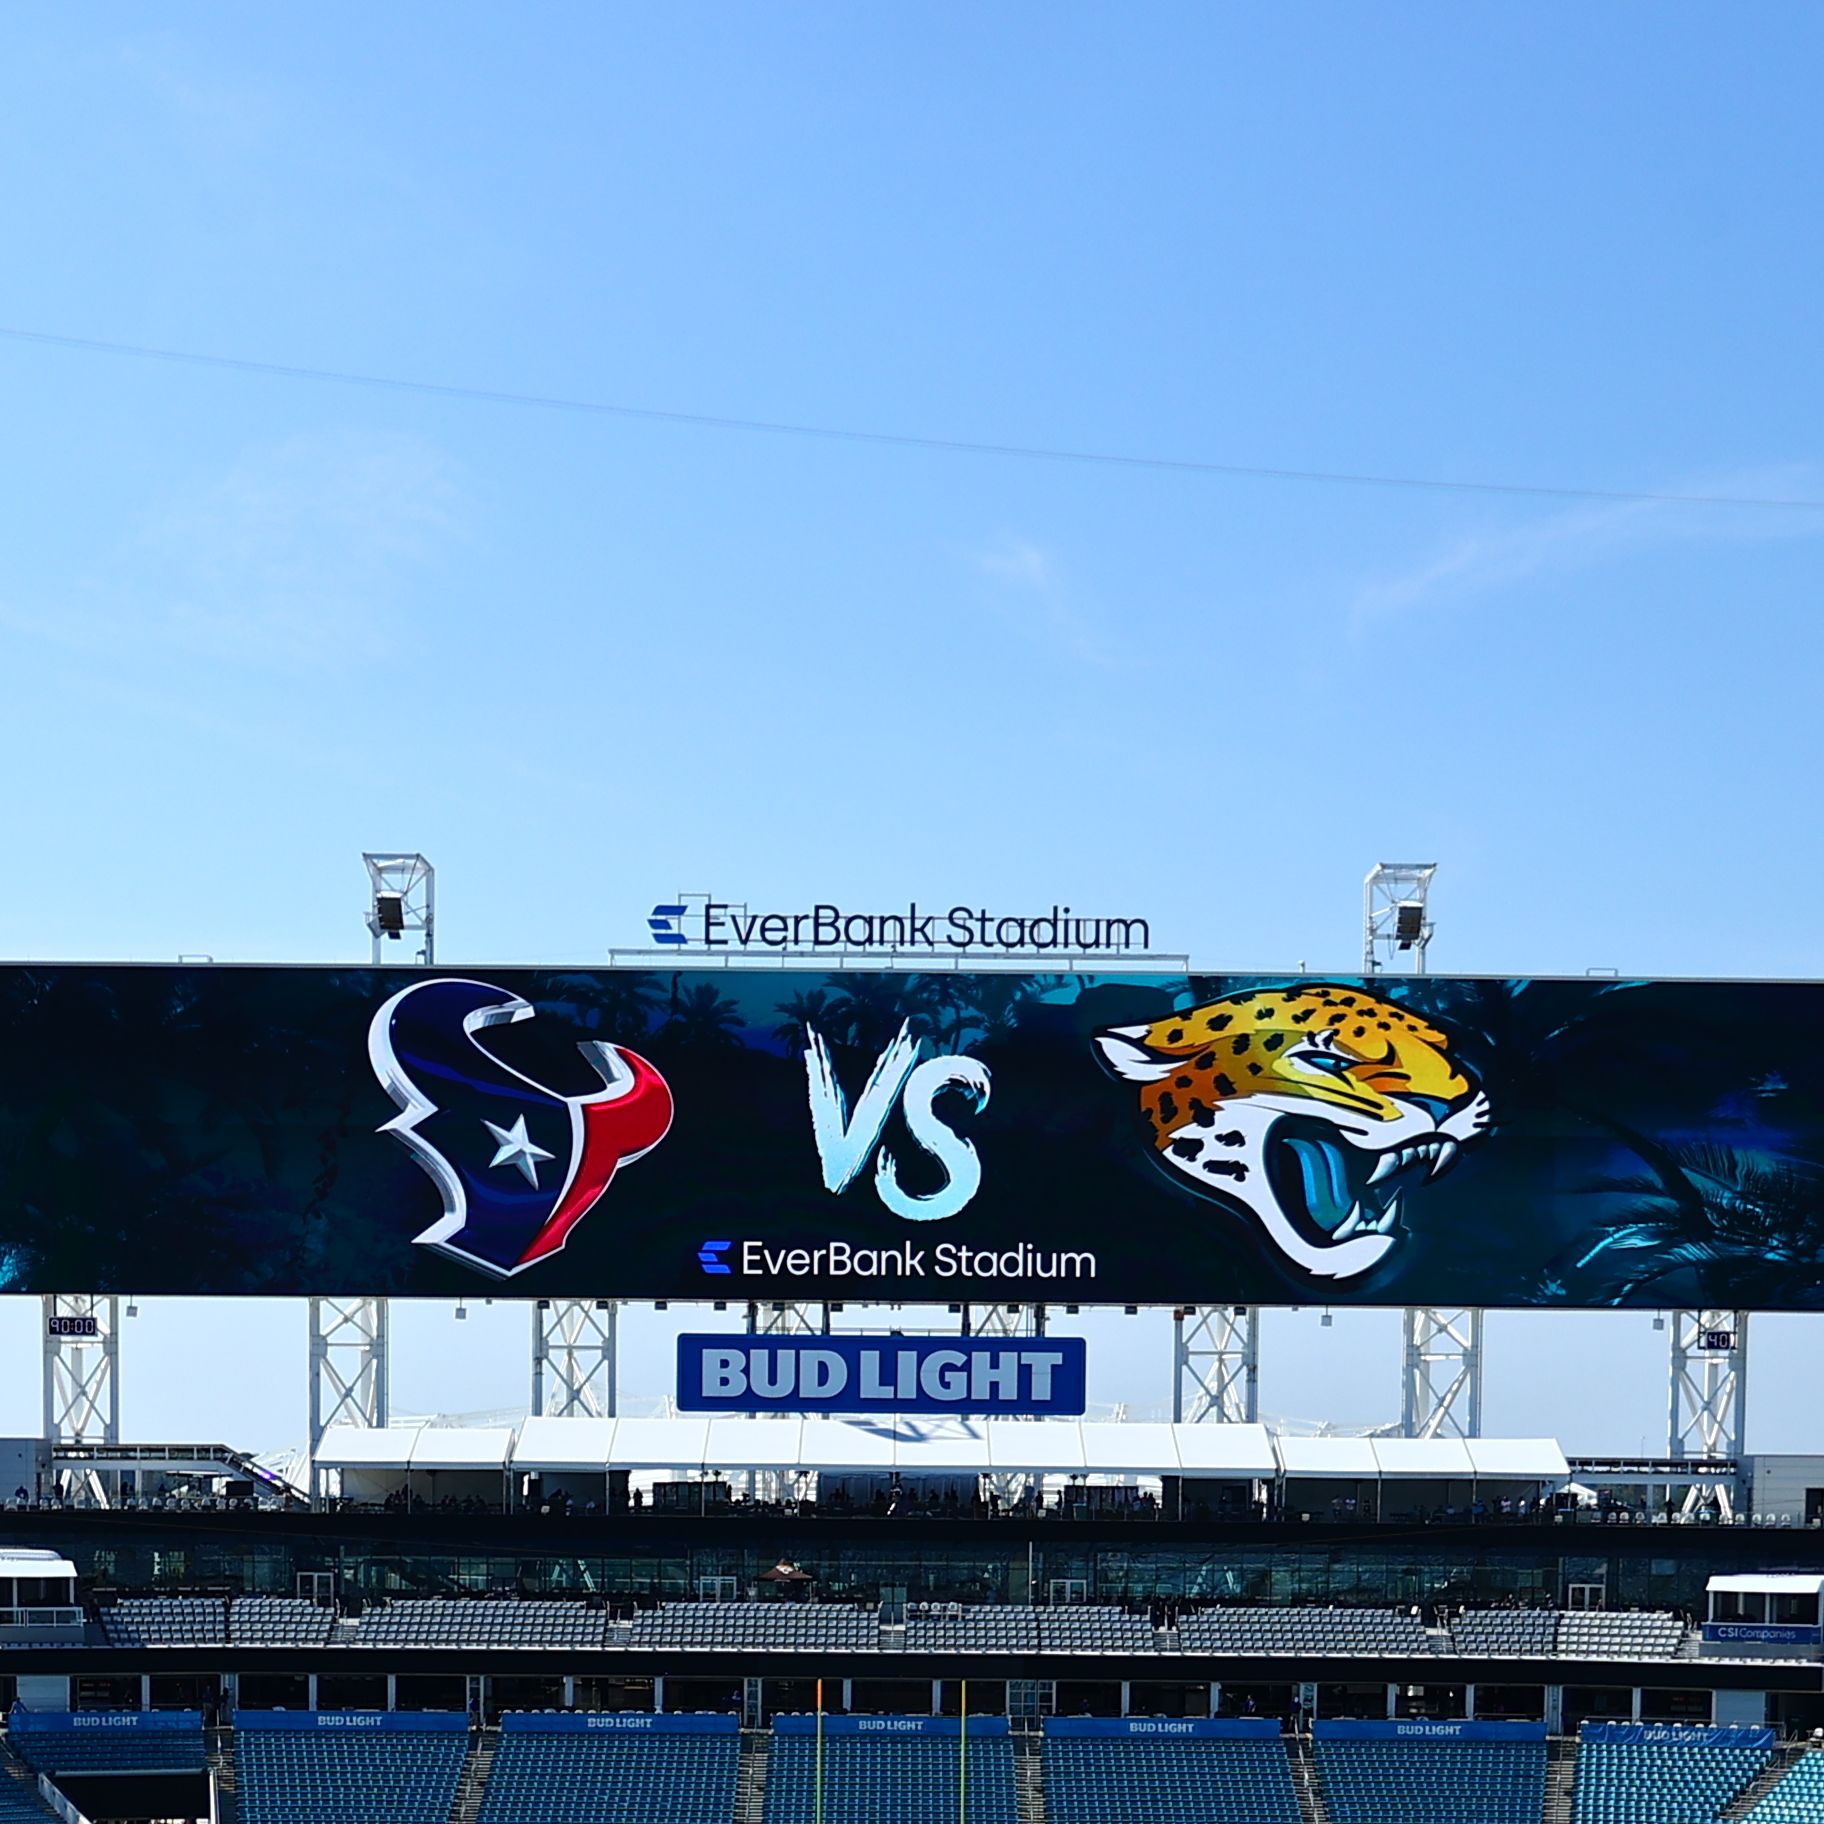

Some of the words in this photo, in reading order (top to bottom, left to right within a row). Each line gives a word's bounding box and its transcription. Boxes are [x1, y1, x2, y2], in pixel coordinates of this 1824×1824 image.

[704, 902, 933, 948] EverBank
[946, 904, 1150, 951] Stadium
[804, 1016, 991, 1222] VS
[742, 1241, 925, 1278] EverBank
[935, 1243, 1097, 1279] Stadium
[51, 1319, 93, 1334] 90:00
[1709, 1333, 1728, 1348] 40
[702, 1348, 847, 1400] BUD
[859, 1349, 1063, 1402] LIGHT
[1717, 1627, 1739, 1638] CSI
[1740, 1629, 1796, 1642] Companies
[73, 1716, 100, 1726] BUD
[101, 1716, 139, 1726] LIGHT
[317, 1716, 345, 1726] BUD
[346, 1716, 383, 1726] LIGHT
[587, 1718, 614, 1728] BUD
[616, 1718, 653, 1728] LIGHT
[859, 1720, 886, 1730] BUD
[887, 1720, 924, 1730] LIGHT
[1129, 1723, 1157, 1733] BUD
[1158, 1723, 1194, 1733] LIGHT
[1397, 1725, 1424, 1735] BUD
[1425, 1725, 1462, 1735] LIGHT
